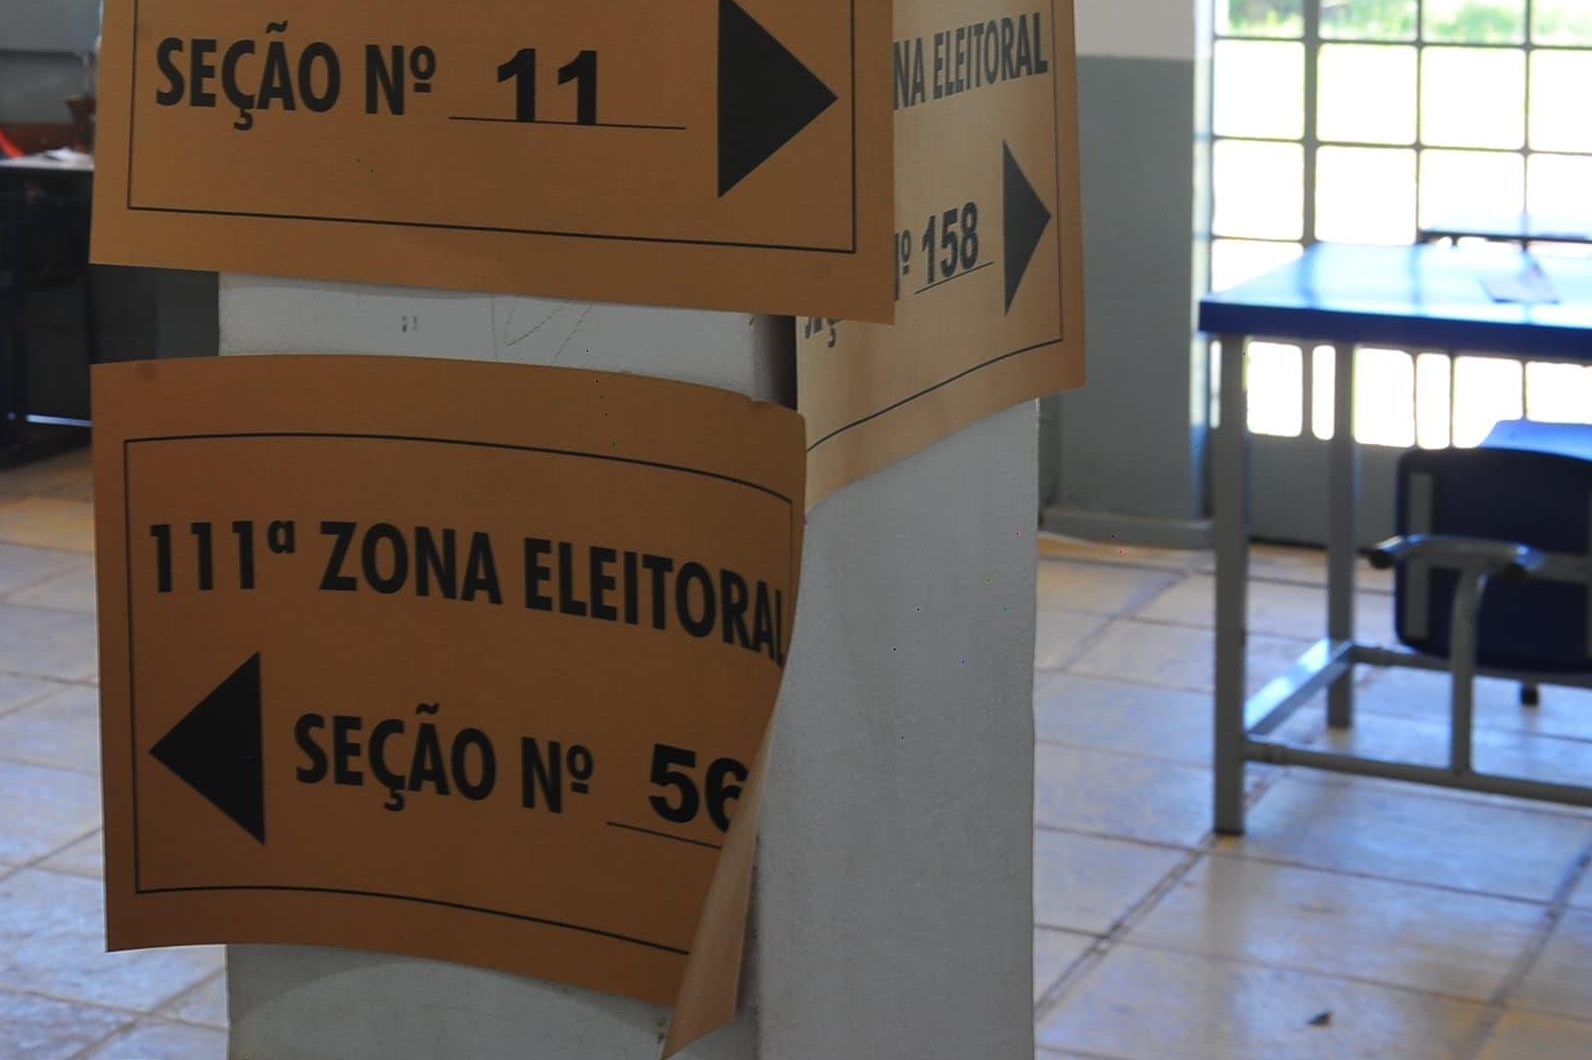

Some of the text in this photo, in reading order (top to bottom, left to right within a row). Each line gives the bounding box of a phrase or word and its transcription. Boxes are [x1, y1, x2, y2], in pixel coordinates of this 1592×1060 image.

[155, 19, 598, 132] SEÇÃO Nº 11
[893, 11, 1049, 111] NA ELEITORAL
[920, 201, 979, 286] 158
[317, 519, 505, 607] ZONA
[292, 701, 751, 835] SEÇÃO Nº 56
